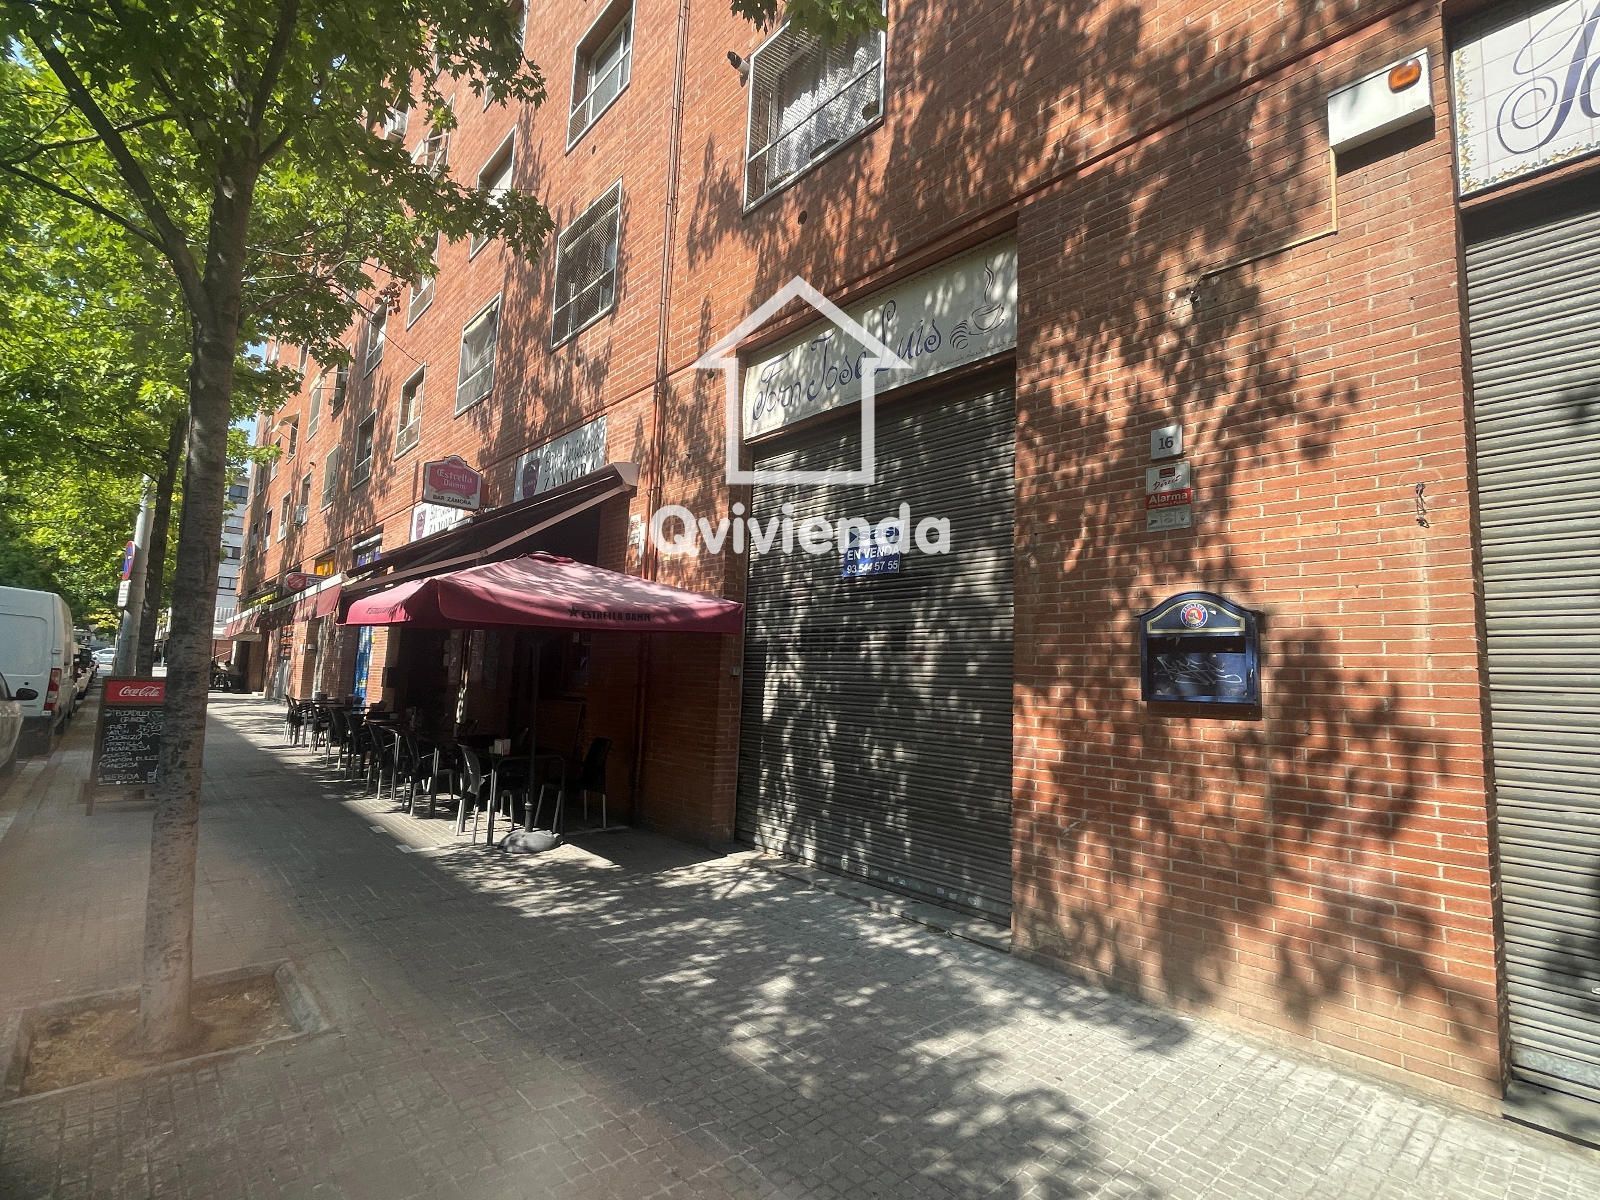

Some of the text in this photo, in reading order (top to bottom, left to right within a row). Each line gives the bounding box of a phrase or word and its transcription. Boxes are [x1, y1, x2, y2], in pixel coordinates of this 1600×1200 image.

[1158, 436, 1174, 450] 16
[437, 469, 472, 483] Estrella
[448, 497, 472, 506] ZAMORA
[1149, 492, 1188, 505] Alarma
[847, 543, 900, 561] EN VENDA
[847, 560, 898, 574] 93 544 57 55
